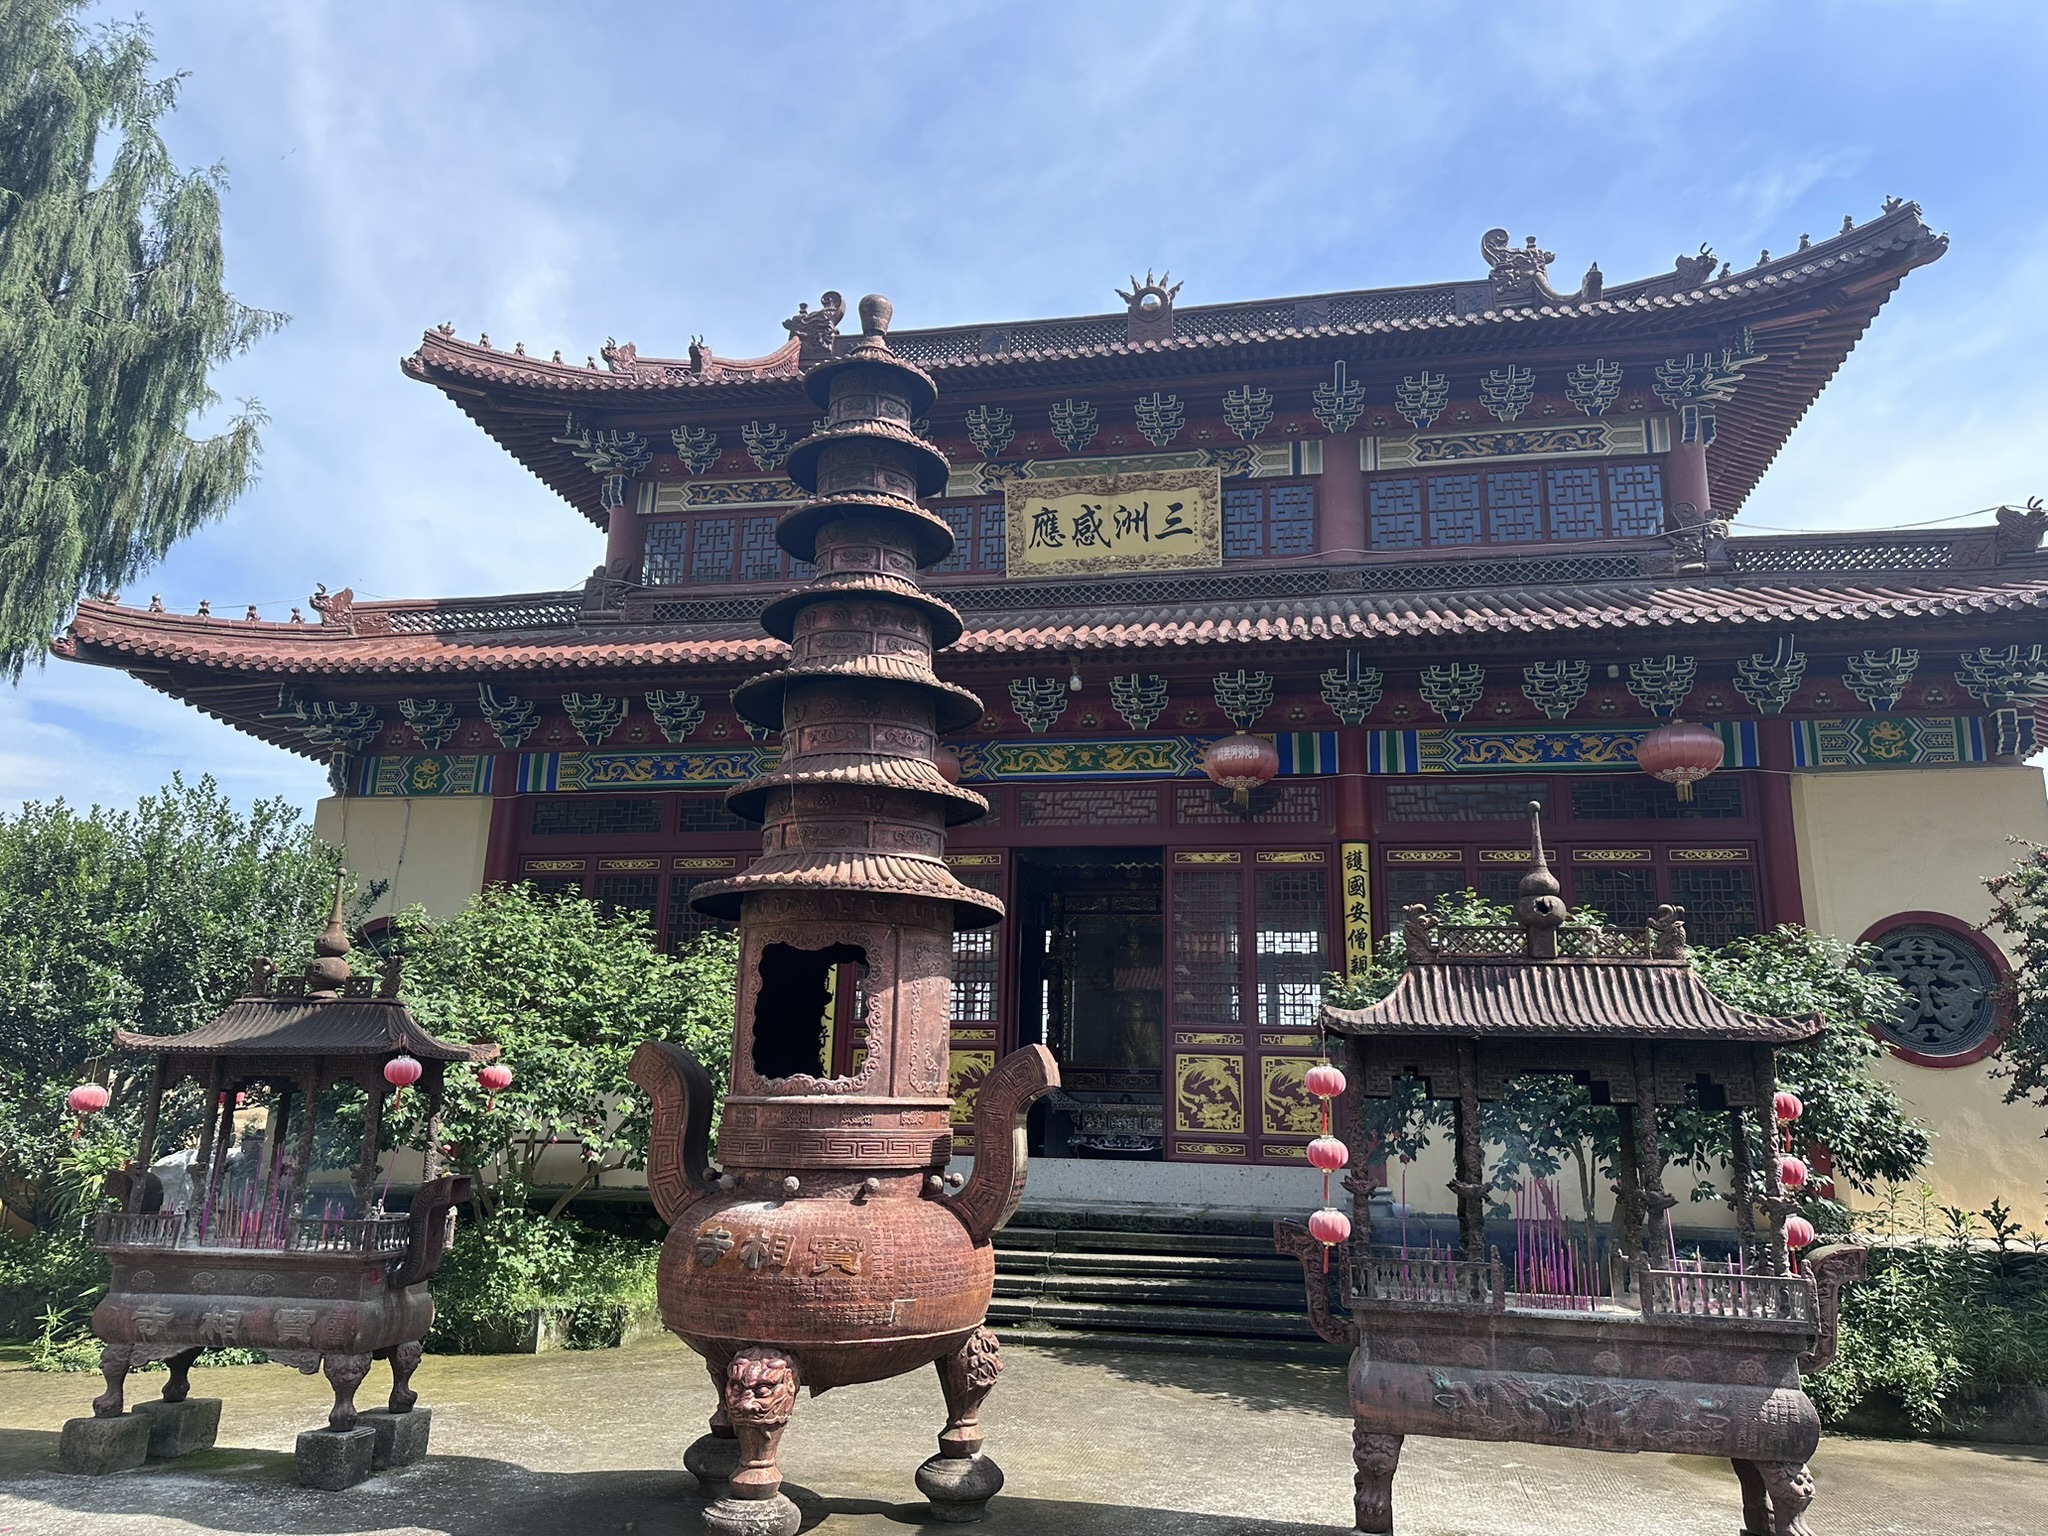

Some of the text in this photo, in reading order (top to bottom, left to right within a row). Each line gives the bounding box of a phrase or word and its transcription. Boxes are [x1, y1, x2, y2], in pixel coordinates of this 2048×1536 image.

[1029, 501, 1194, 550] 三洲感應
[1344, 849, 1370, 976] 護國安僧親
